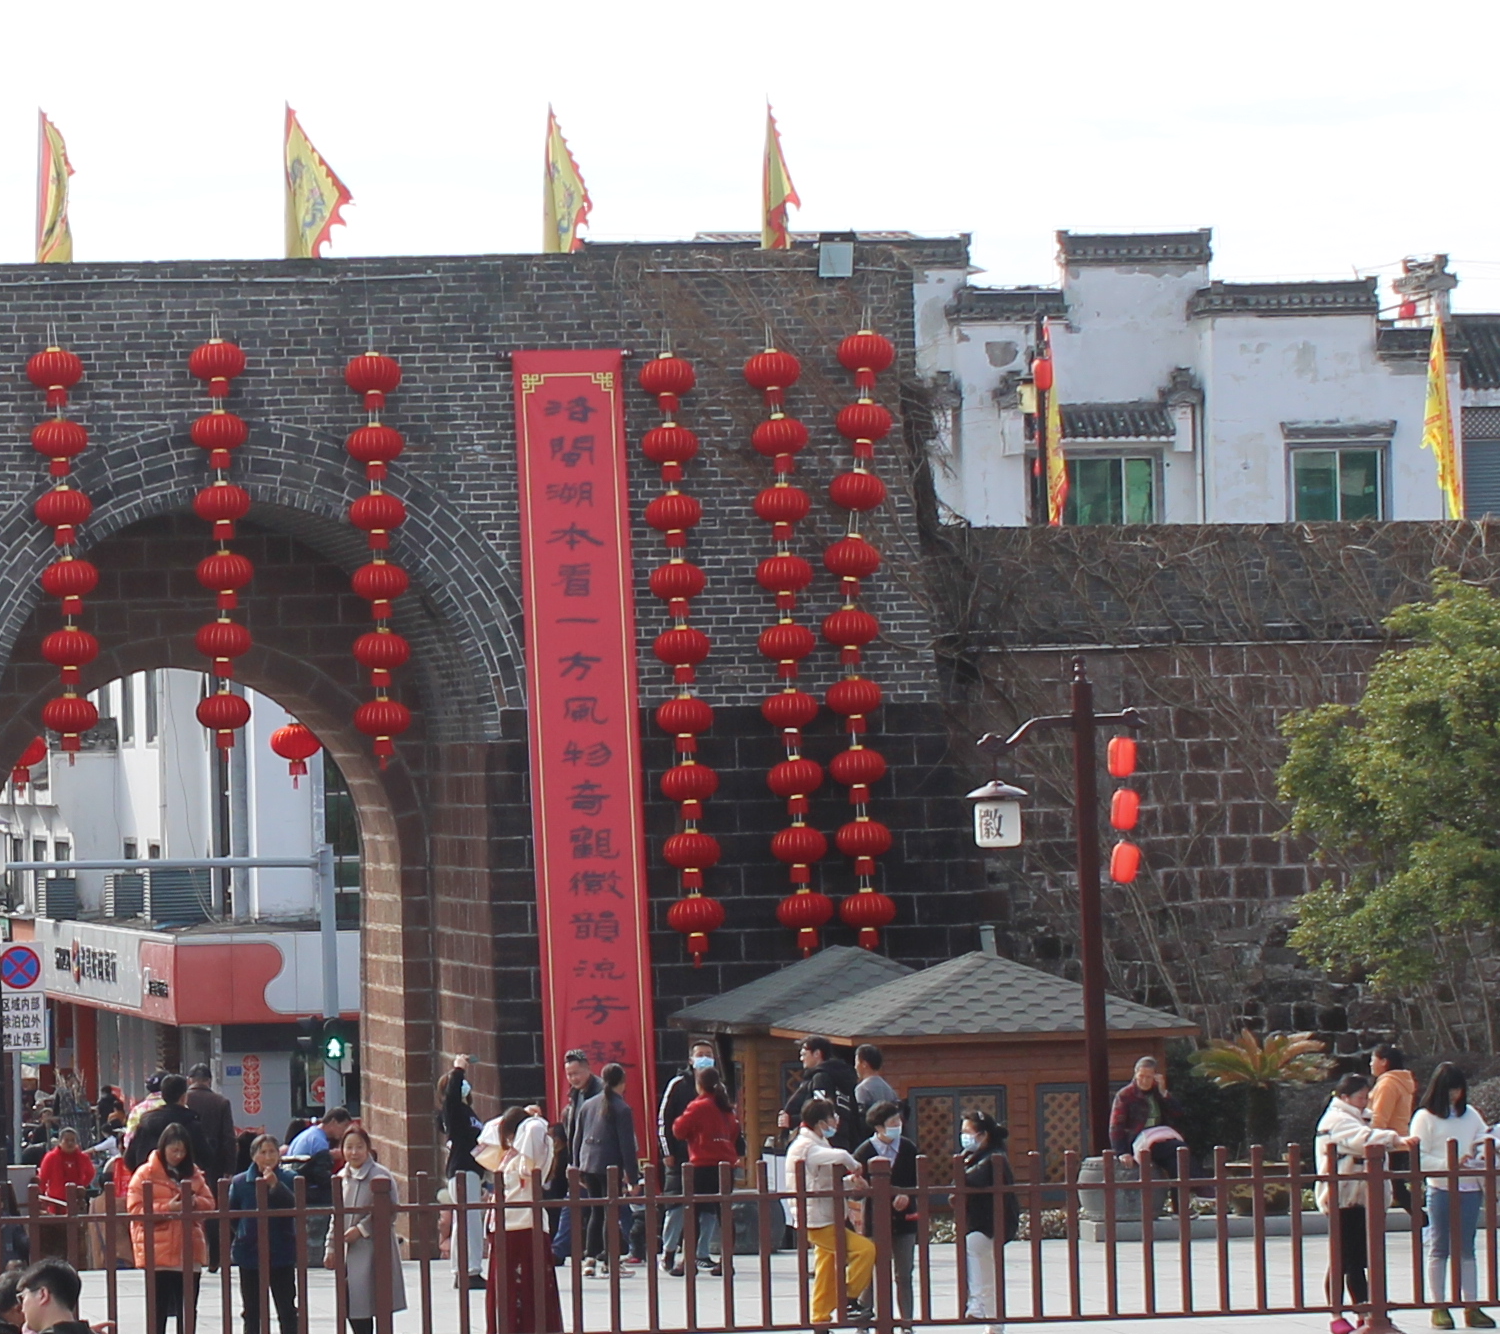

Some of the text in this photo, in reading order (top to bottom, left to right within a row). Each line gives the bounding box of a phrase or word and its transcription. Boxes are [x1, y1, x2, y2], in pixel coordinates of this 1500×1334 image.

[2, 997, 40, 1012] 区域内部
[3, 1033, 41, 1047] 禁止停车
